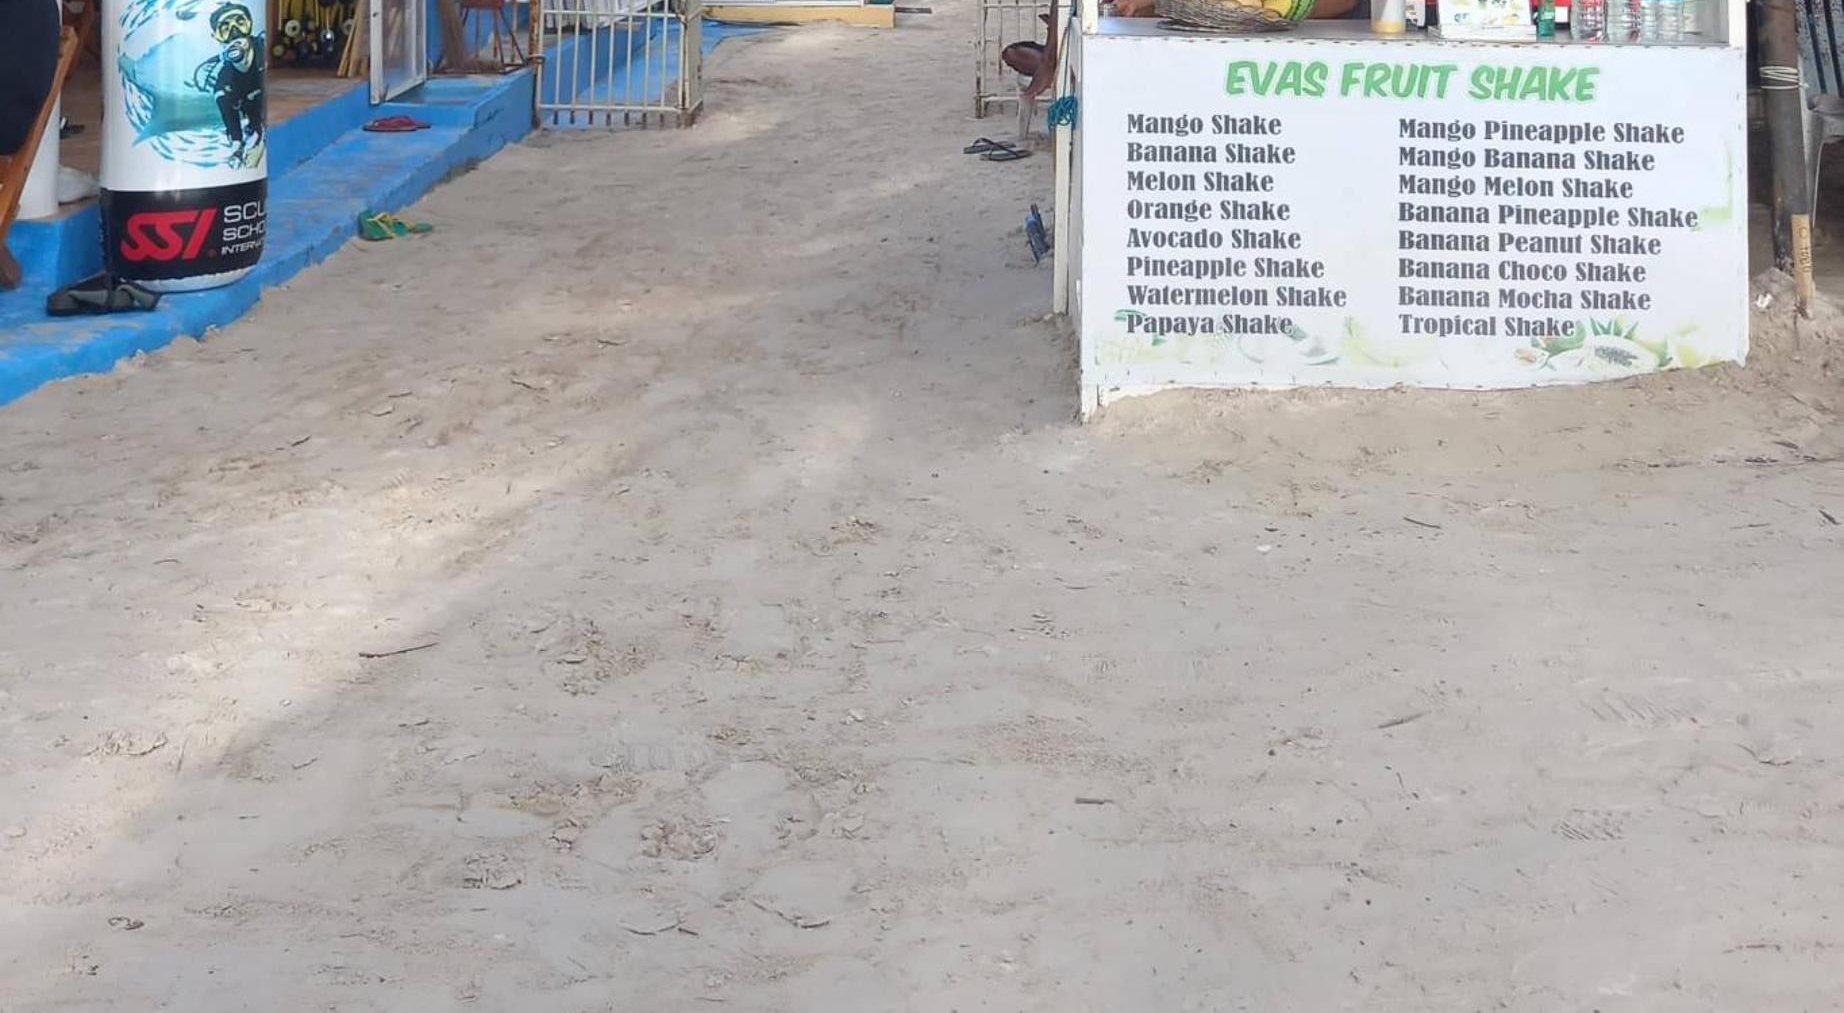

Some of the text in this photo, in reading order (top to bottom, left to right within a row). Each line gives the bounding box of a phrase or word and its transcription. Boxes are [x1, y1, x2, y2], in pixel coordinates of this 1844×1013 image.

[1225, 60, 1601, 102] EVAS FRUIT SHAKE
[1128, 114, 1281, 136] Mango Shake
[1400, 119, 1684, 144] Mango Pineapple Shake
[1128, 143, 1295, 163] Banana Shake
[1399, 147, 1654, 170] Mango Banana Shake
[1128, 171, 1273, 192] Melon Shake
[1400, 175, 1632, 198] Mango Melon Shake
[1128, 200, 1289, 222] Orange Shake
[1399, 203, 1697, 228] Banana Pineapple Shake
[120, 208, 218, 261] SSI
[1127, 228, 1300, 249] Avocado Shake
[1399, 230, 1660, 254] Banana Peanut Shake
[1128, 256, 1324, 279] Pineapple Shake
[1399, 258, 1645, 282] Banana Choco Shake
[1128, 285, 1346, 307] Watermelon Shake
[1399, 286, 1650, 310] Banana Mocha Shake
[1128, 314, 1292, 336] Papaya Shake
[1399, 314, 1574, 337] Tropical Shake
